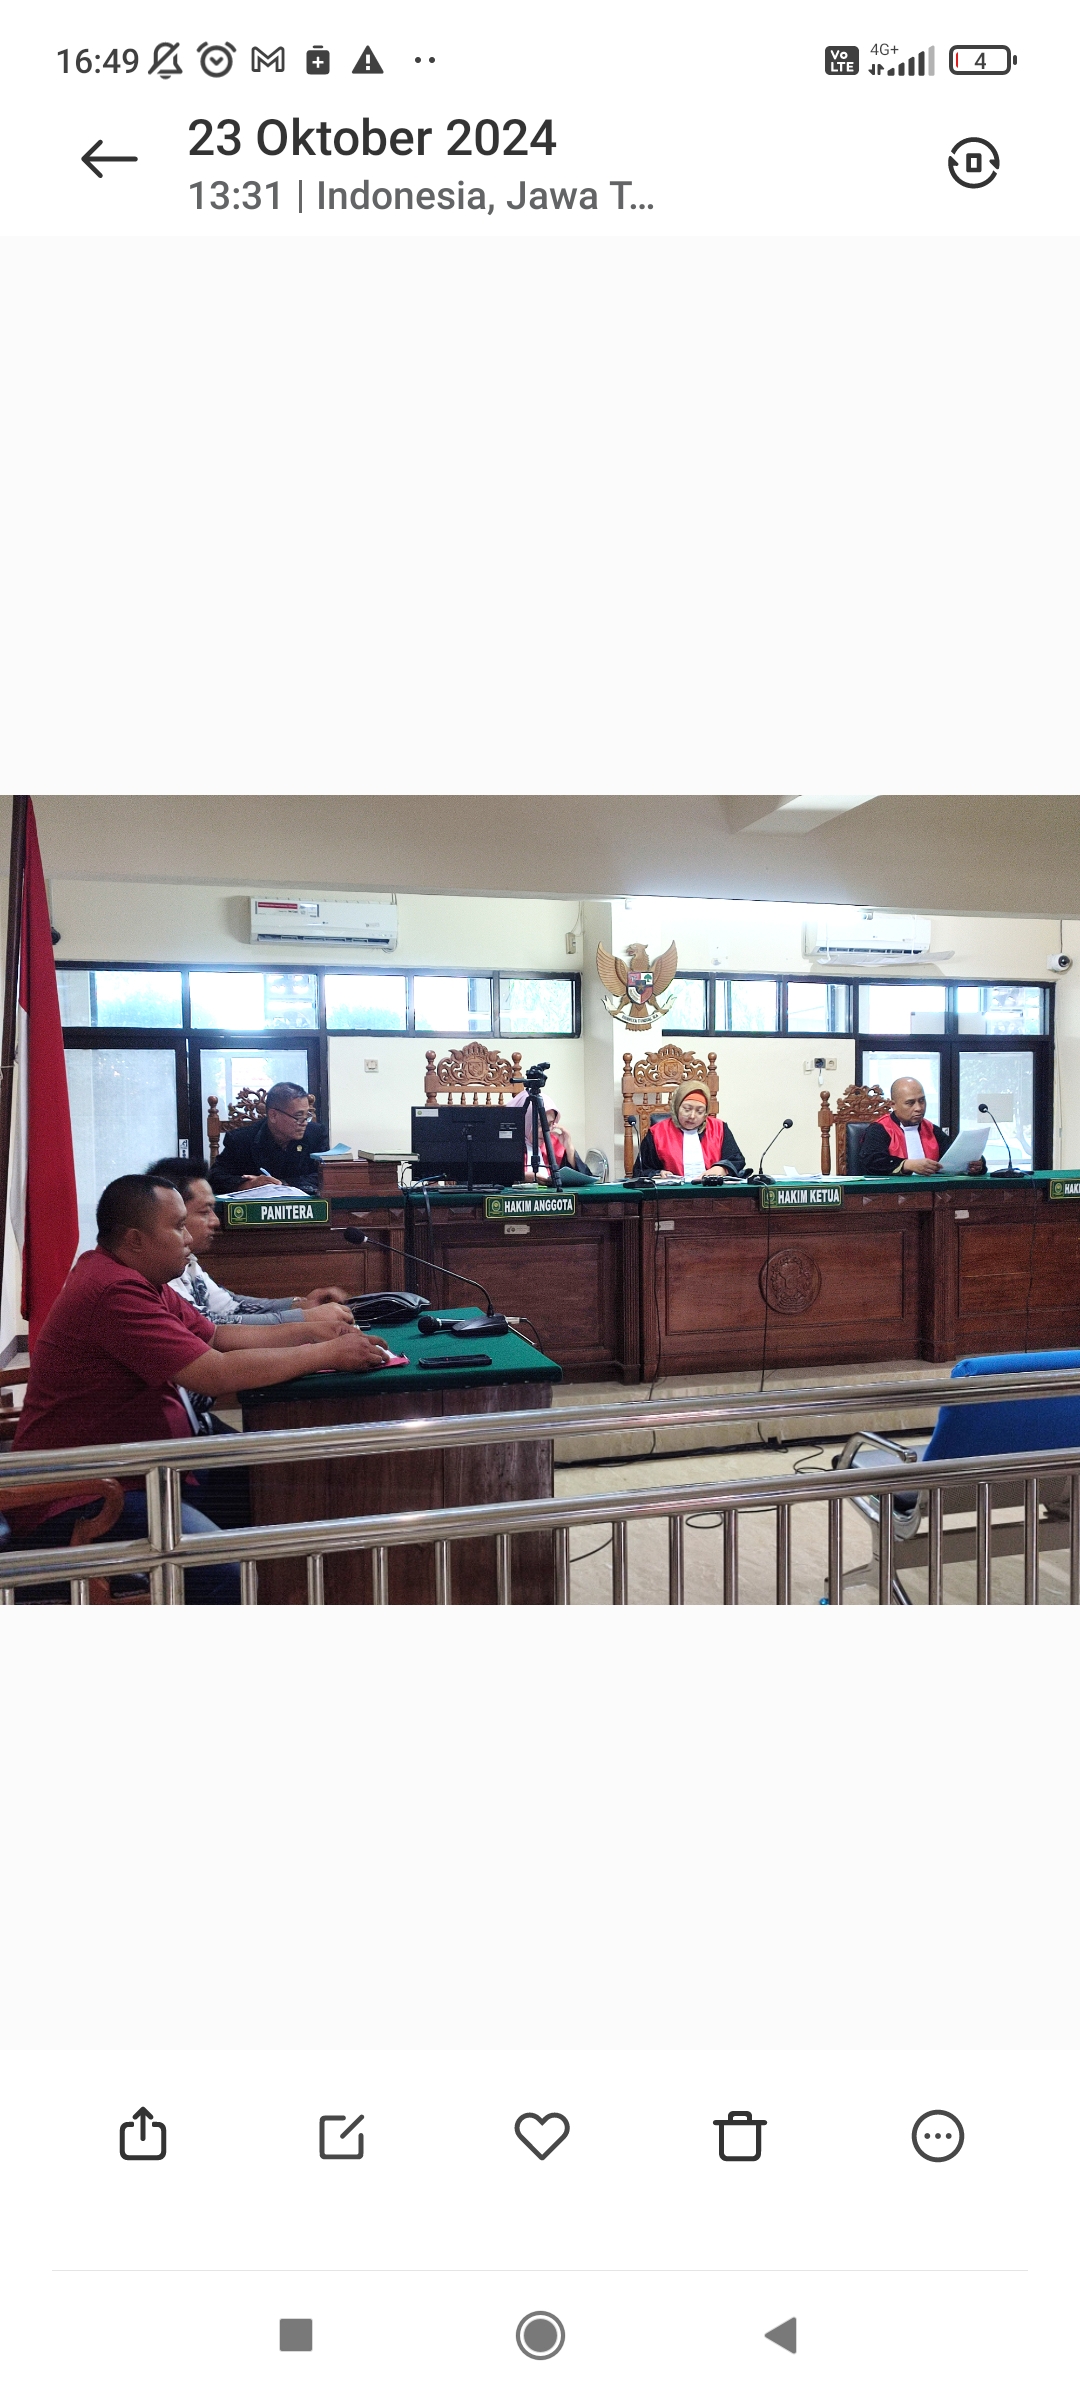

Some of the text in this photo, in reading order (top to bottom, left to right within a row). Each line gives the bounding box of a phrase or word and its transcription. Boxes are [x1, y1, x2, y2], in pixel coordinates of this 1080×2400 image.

[778, 1188, 840, 1204] HAKIM KETUA
[261, 1204, 314, 1220] PANITERA
[504, 1198, 573, 1213] HAKIM ANGGOTA
